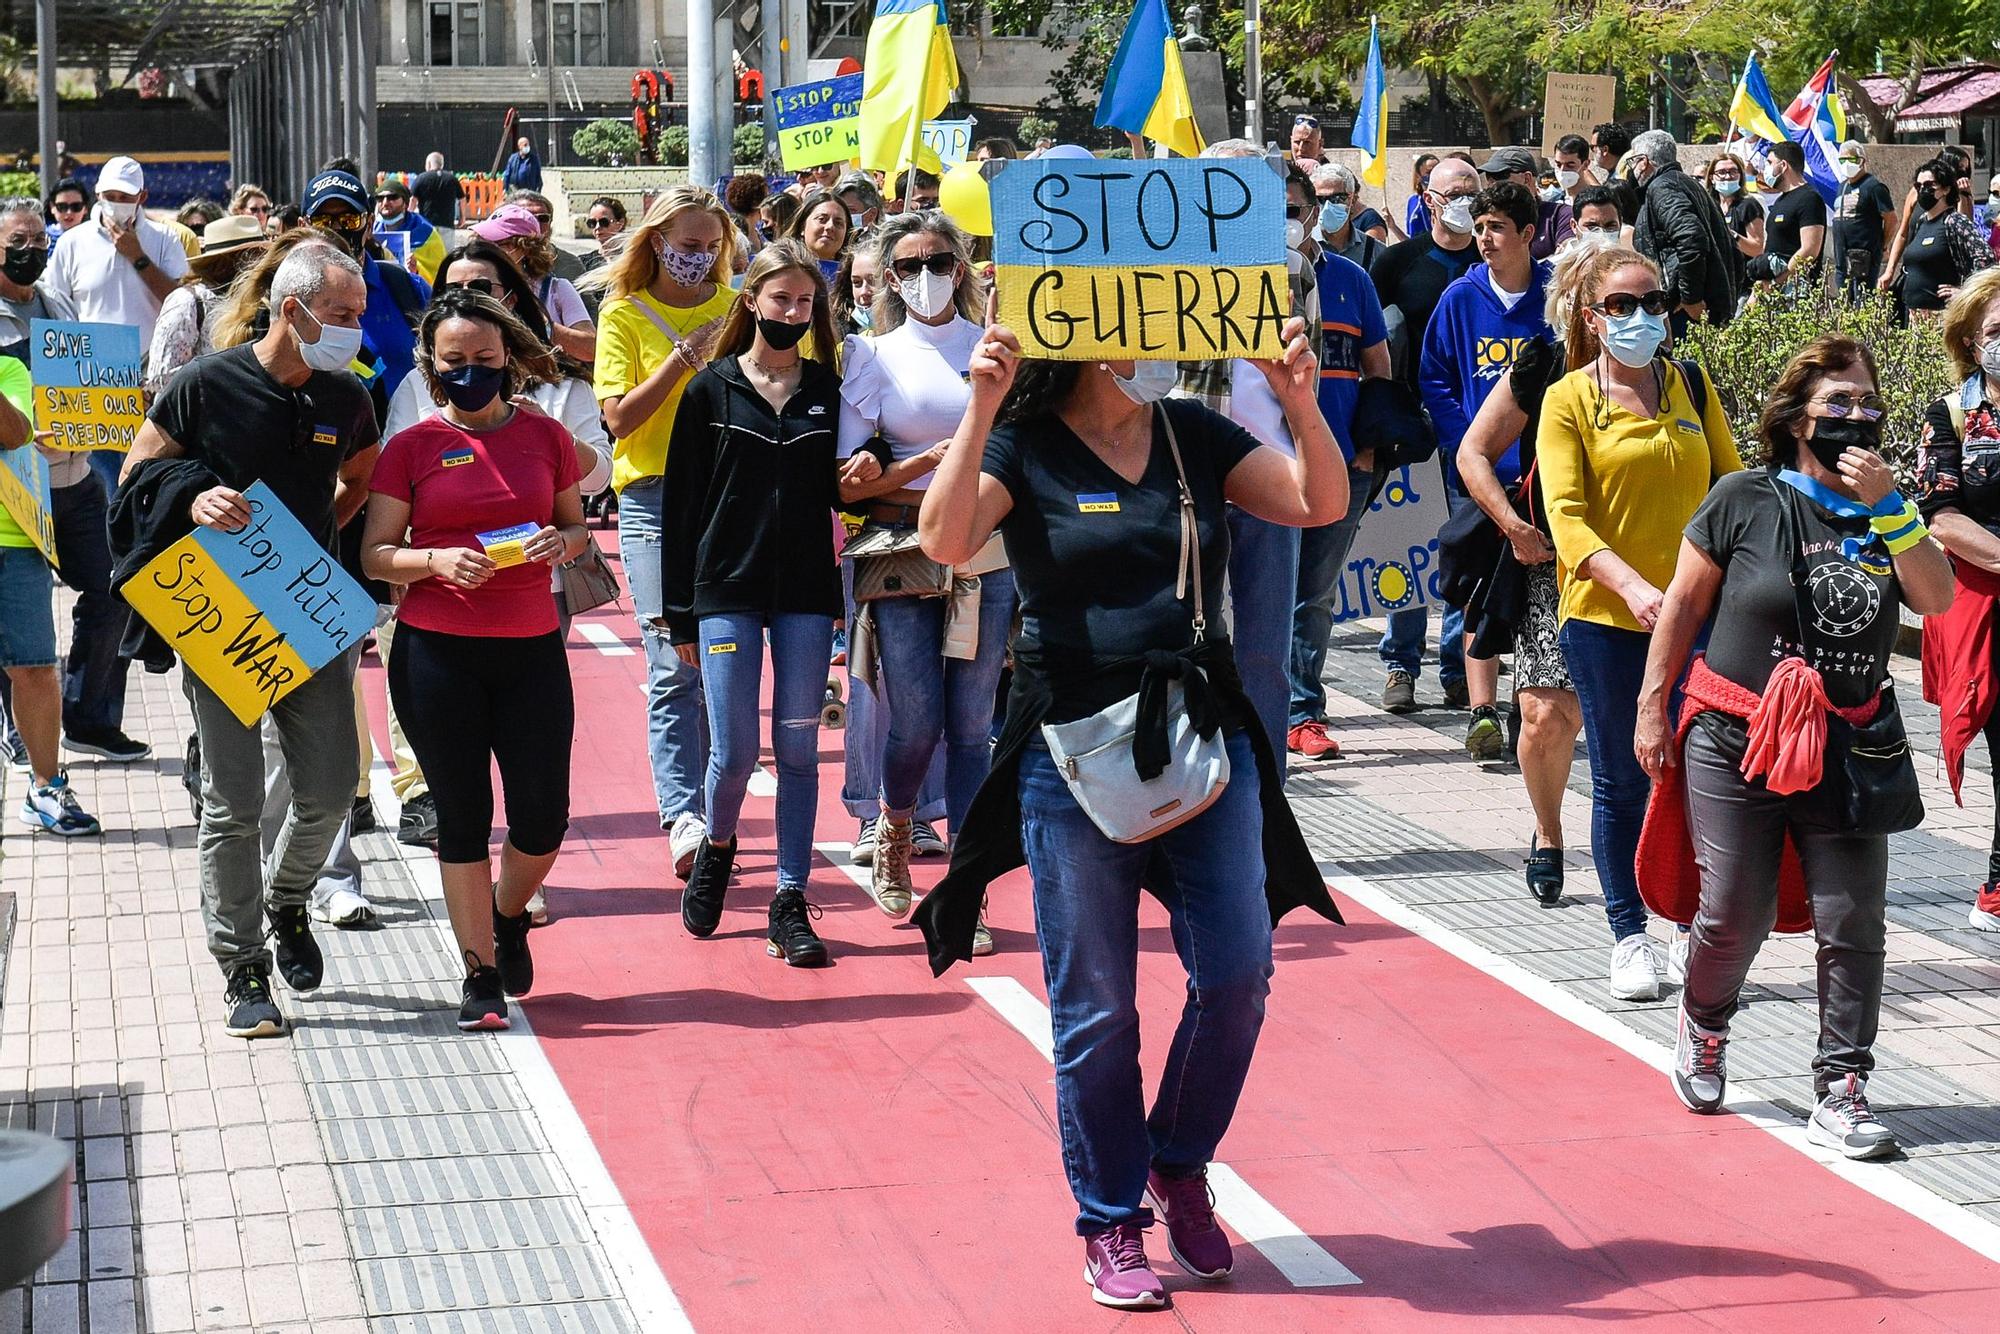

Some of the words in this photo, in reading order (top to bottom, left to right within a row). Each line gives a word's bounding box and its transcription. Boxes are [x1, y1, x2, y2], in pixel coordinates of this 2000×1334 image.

[832, 99, 861, 117] PUT
[793, 126, 834, 151] STOP
[845, 131, 859, 148] W
[921, 128, 967, 157] TOP
[310, 175, 360, 197] Titleist
[1019, 167, 1252, 255] STOP
[1027, 266, 1290, 352] GUERRA
[43, 328, 93, 359] SAVE
[45, 387, 92, 415] SAVE
[103, 394, 142, 416] OUR
[50, 420, 136, 448] FREEDOM
[489, 531, 529, 544] UCRANIA
[225, 499, 283, 579] Stop
[285, 556, 350, 651] Putin
[1873, 566, 1887, 574] WAR
[153, 552, 223, 640] Stop
[222, 611, 294, 711] WAR
